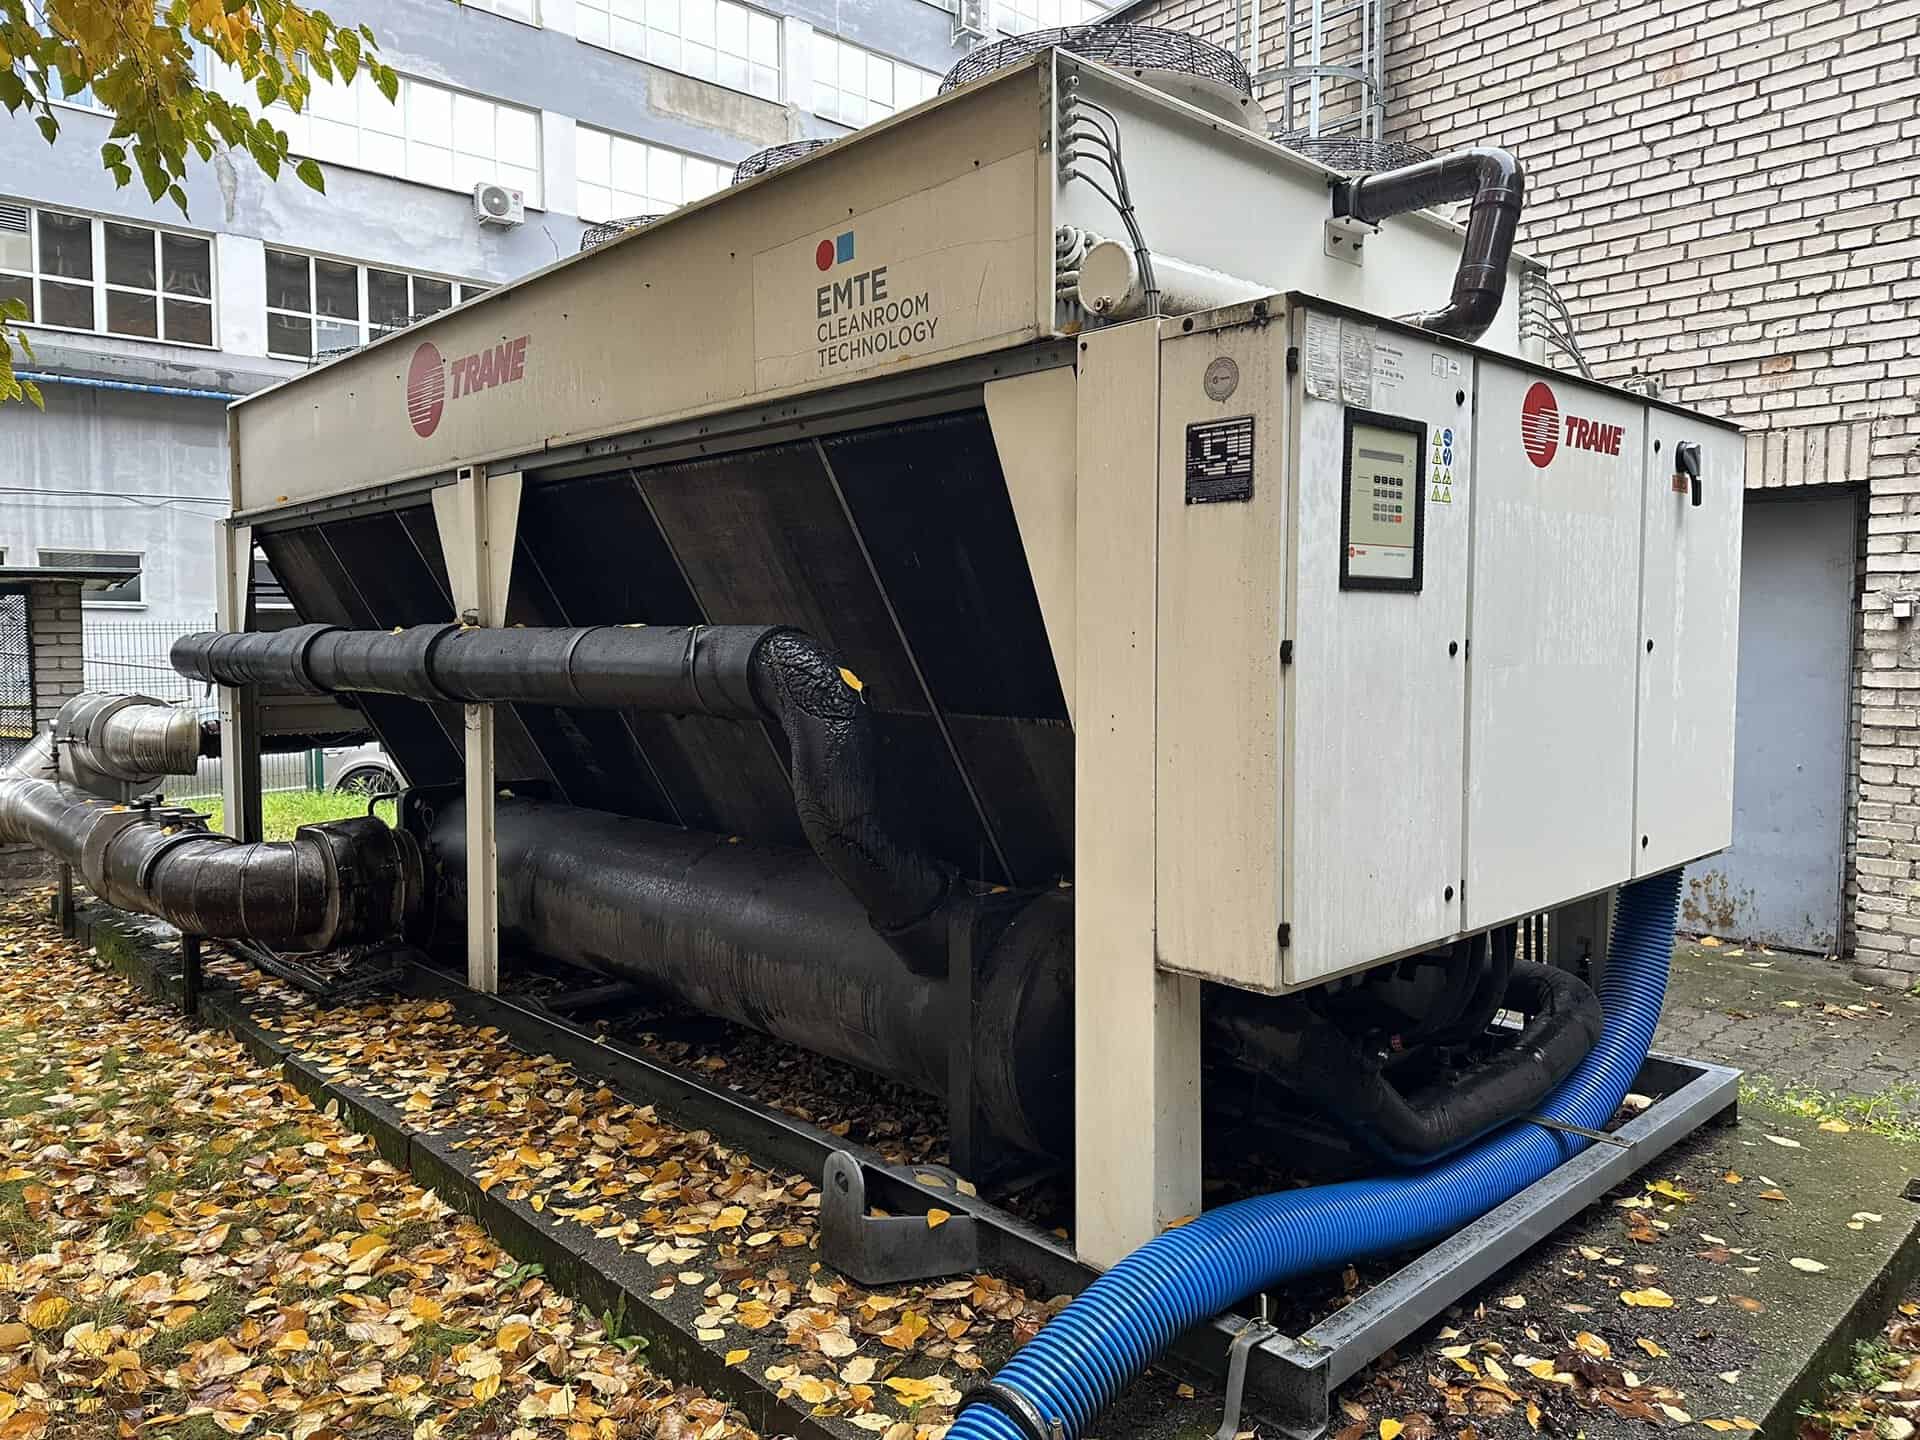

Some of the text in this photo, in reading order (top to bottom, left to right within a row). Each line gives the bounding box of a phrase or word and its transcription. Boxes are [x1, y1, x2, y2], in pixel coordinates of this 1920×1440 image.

[816, 266, 888, 319] EMTE
[817, 292, 929, 343] CLEANROOM
[451, 335, 528, 399] TRANE
[817, 317, 938, 368] TECHNOLOGY
[1565, 415, 1624, 456] TRANE
